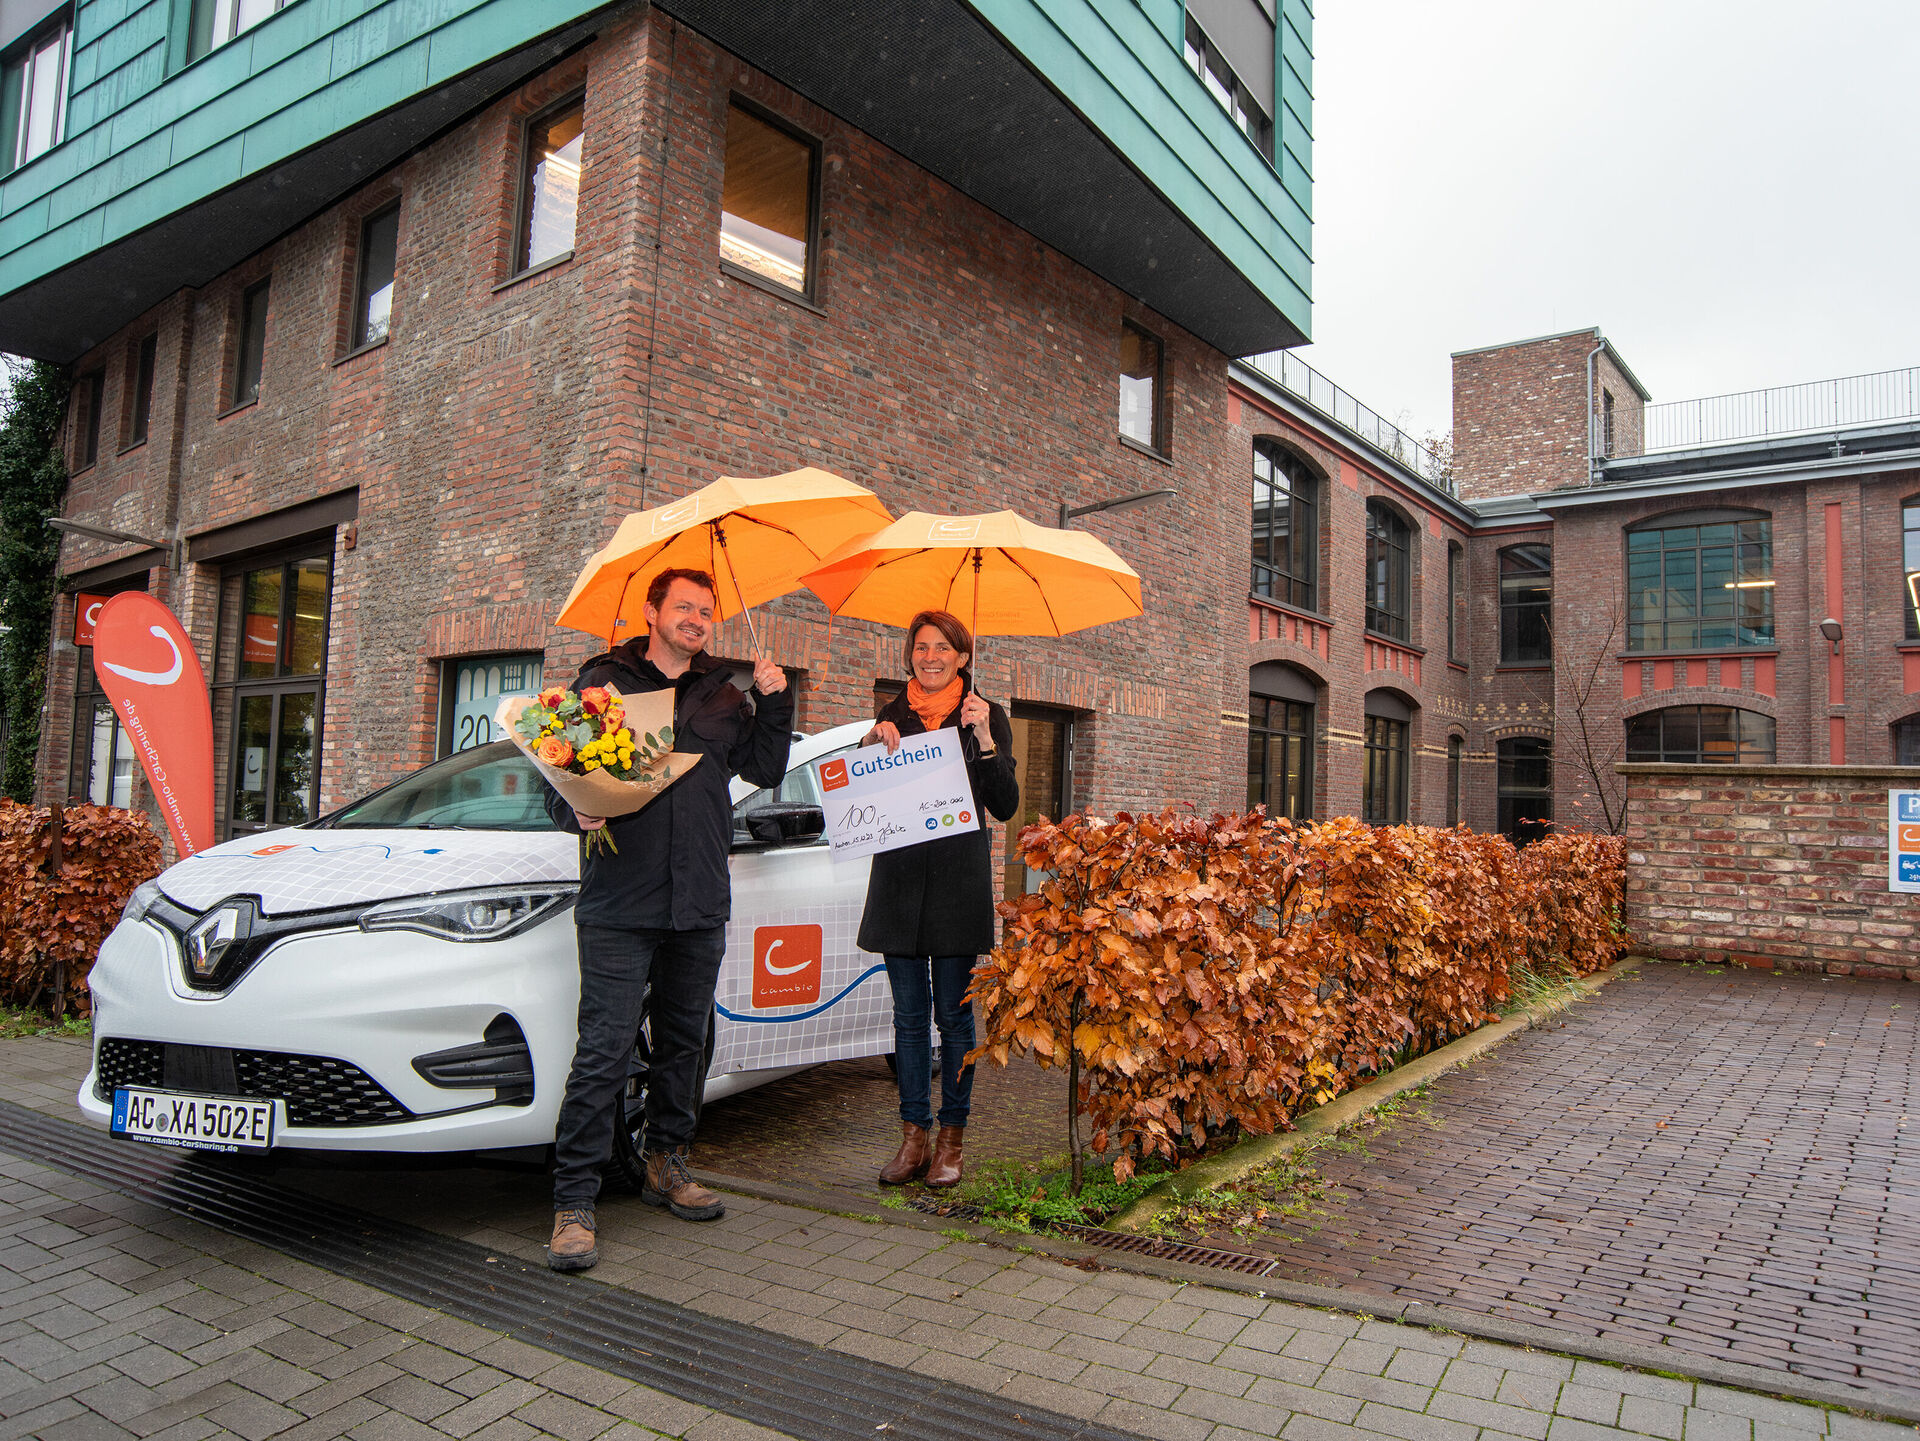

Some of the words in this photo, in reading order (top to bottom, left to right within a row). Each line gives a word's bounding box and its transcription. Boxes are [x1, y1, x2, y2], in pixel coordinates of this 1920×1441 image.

[851, 744, 943, 777] Gutschein
[760, 984, 813, 995] cambio
[117, 1114, 124, 1125] D
